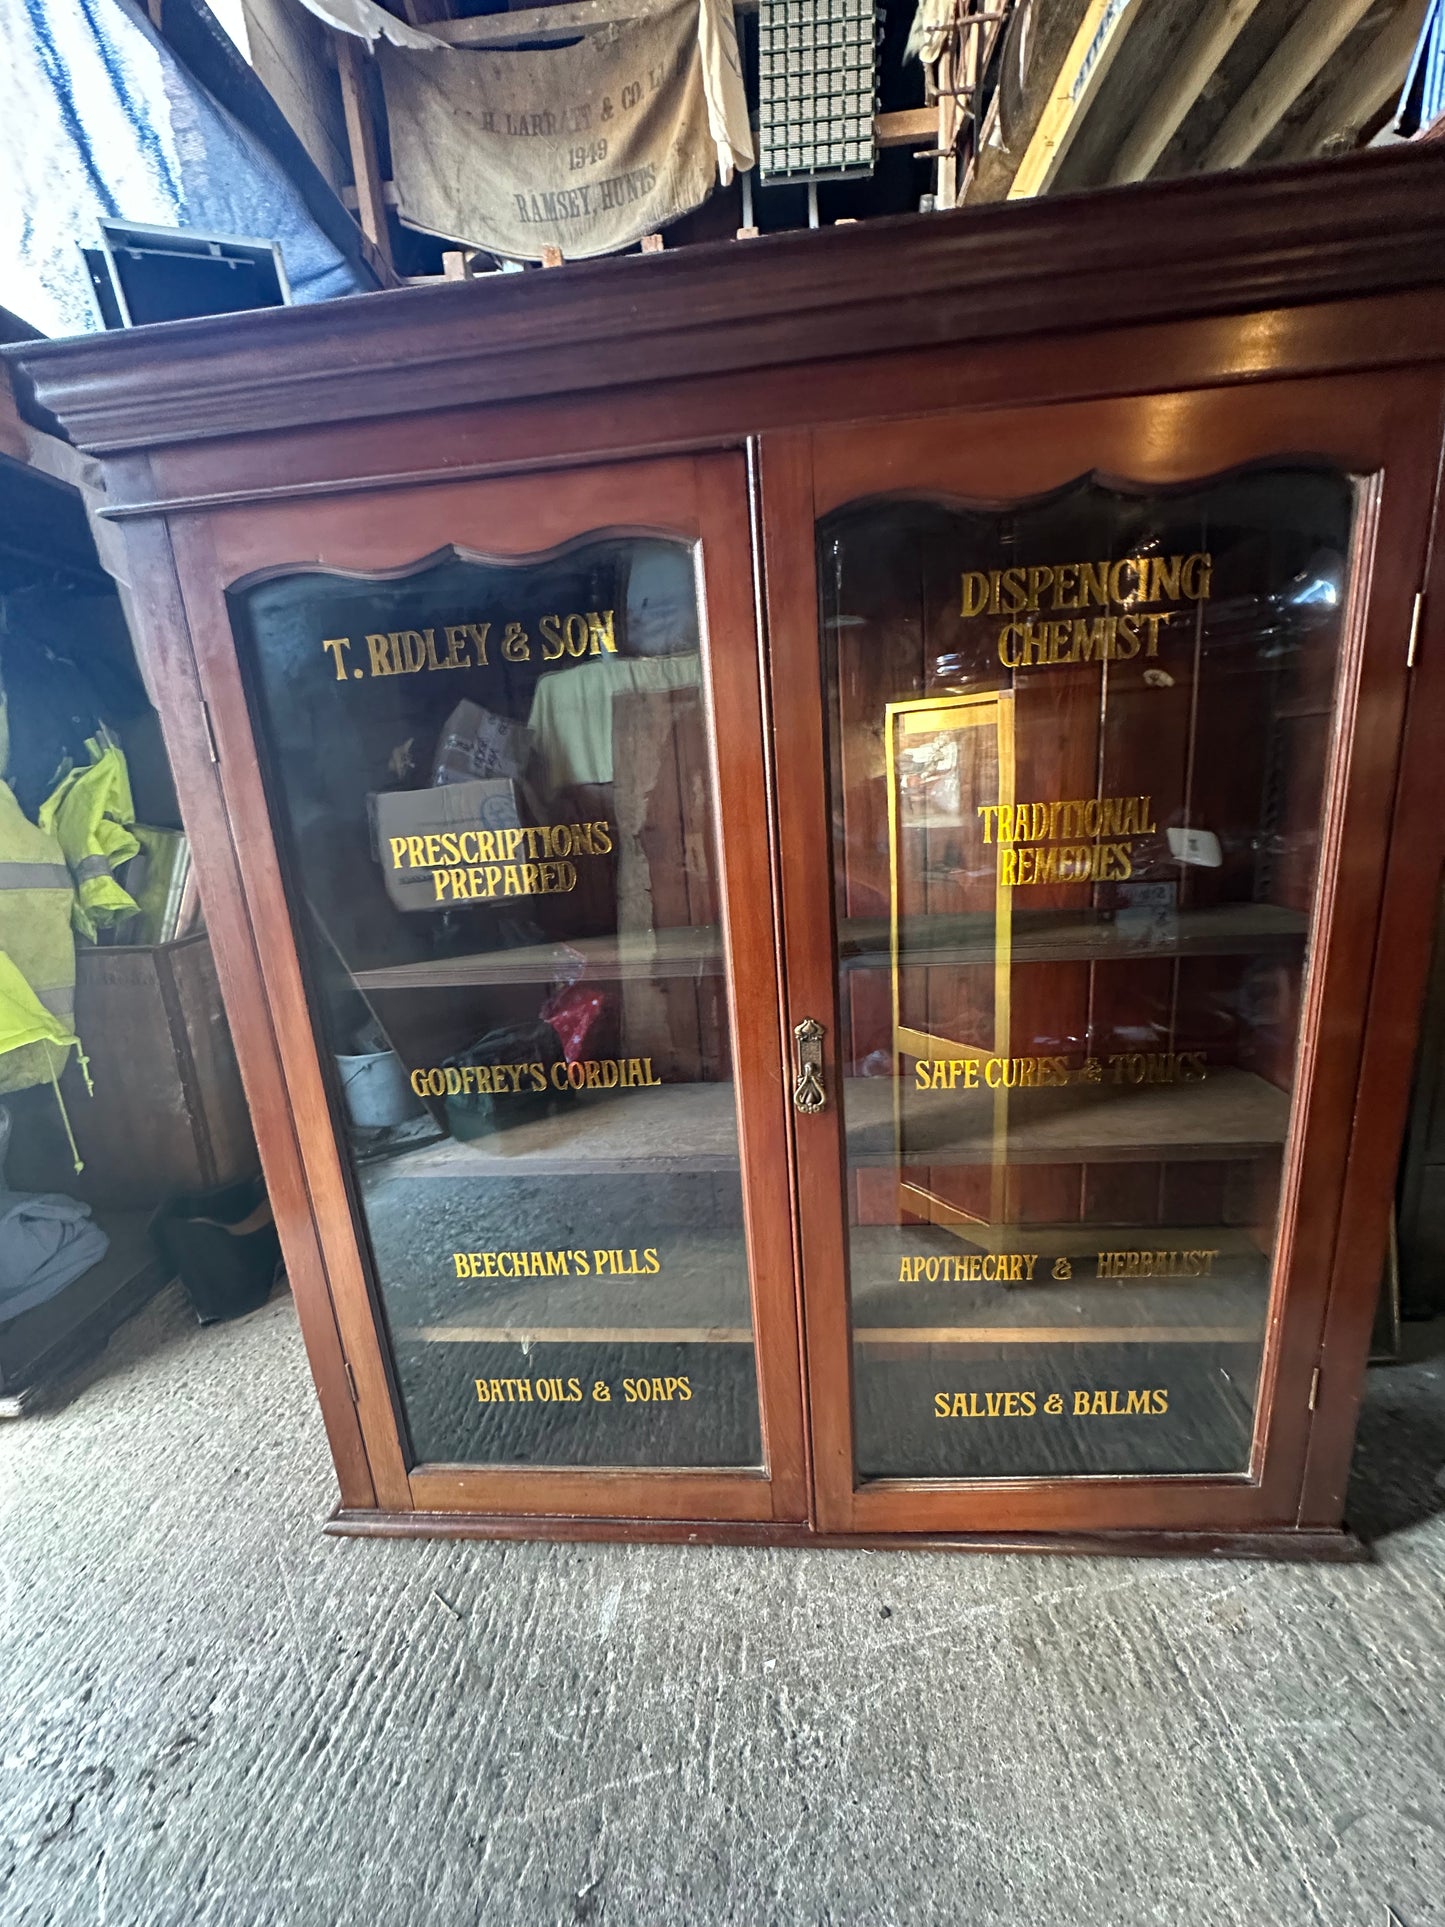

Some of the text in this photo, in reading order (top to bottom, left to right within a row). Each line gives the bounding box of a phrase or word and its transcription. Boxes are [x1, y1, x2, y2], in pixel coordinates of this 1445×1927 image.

[600, 96, 615, 122] &
[568, 138, 608, 171] 1949
[960, 553, 1213, 618] DISPENCING
[322, 610, 618, 681] T. RIDLEY & SON
[998, 612, 1170, 668] CHEMIST
[977, 796, 1157, 845] TRADITIONAL
[389, 821, 613, 869] PRESCRIPTIONS
[1001, 842, 1133, 886] REMEDIES
[432, 861, 577, 901] PREPARED
[410, 1057, 661, 1098] GODFREY'S CORDIAL
[915, 1052, 1207, 1090] SAFE CURES & TONICS
[453, 1248, 661, 1278] BEECHAM'S PILLS
[899, 1249, 1218, 1282] APOTHECARY & HERBALIST
[475, 1376, 693, 1402] BATH OILS & SOAPS
[934, 1389, 1169, 1418] SALVES & BALMS
